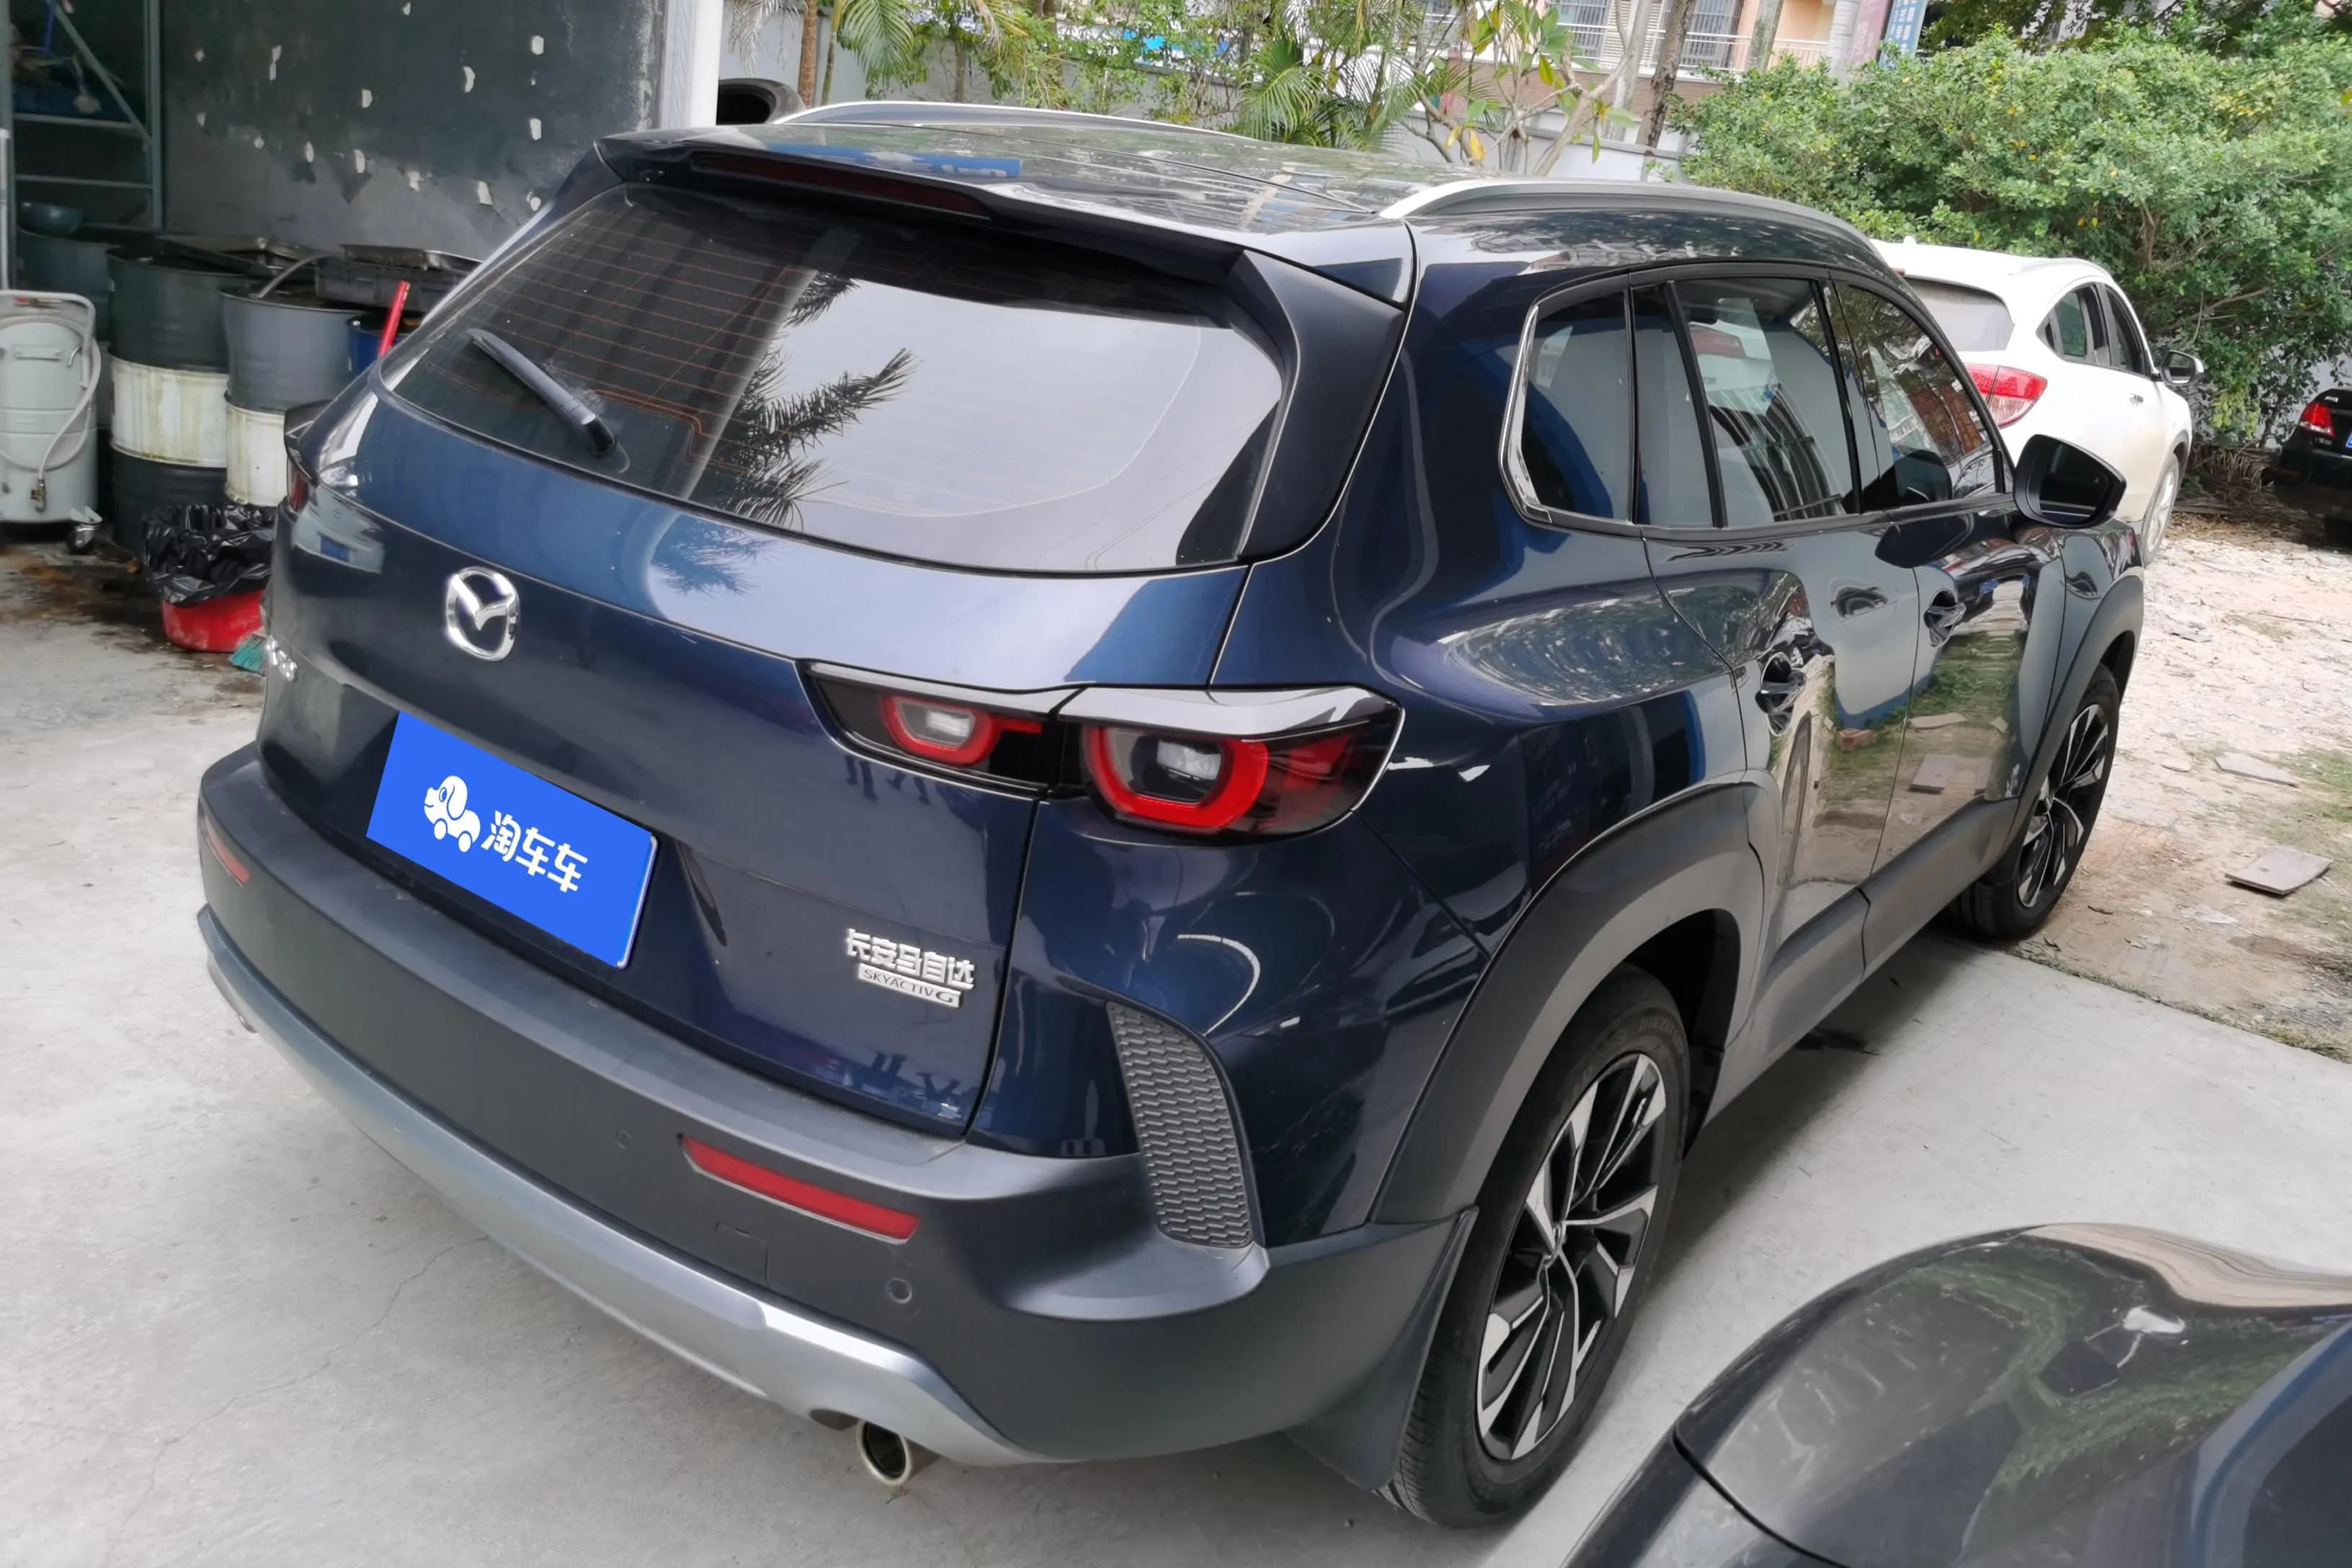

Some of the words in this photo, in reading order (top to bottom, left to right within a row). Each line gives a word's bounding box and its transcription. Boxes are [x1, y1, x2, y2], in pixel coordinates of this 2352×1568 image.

[846, 927, 975, 990] 长安马自达
